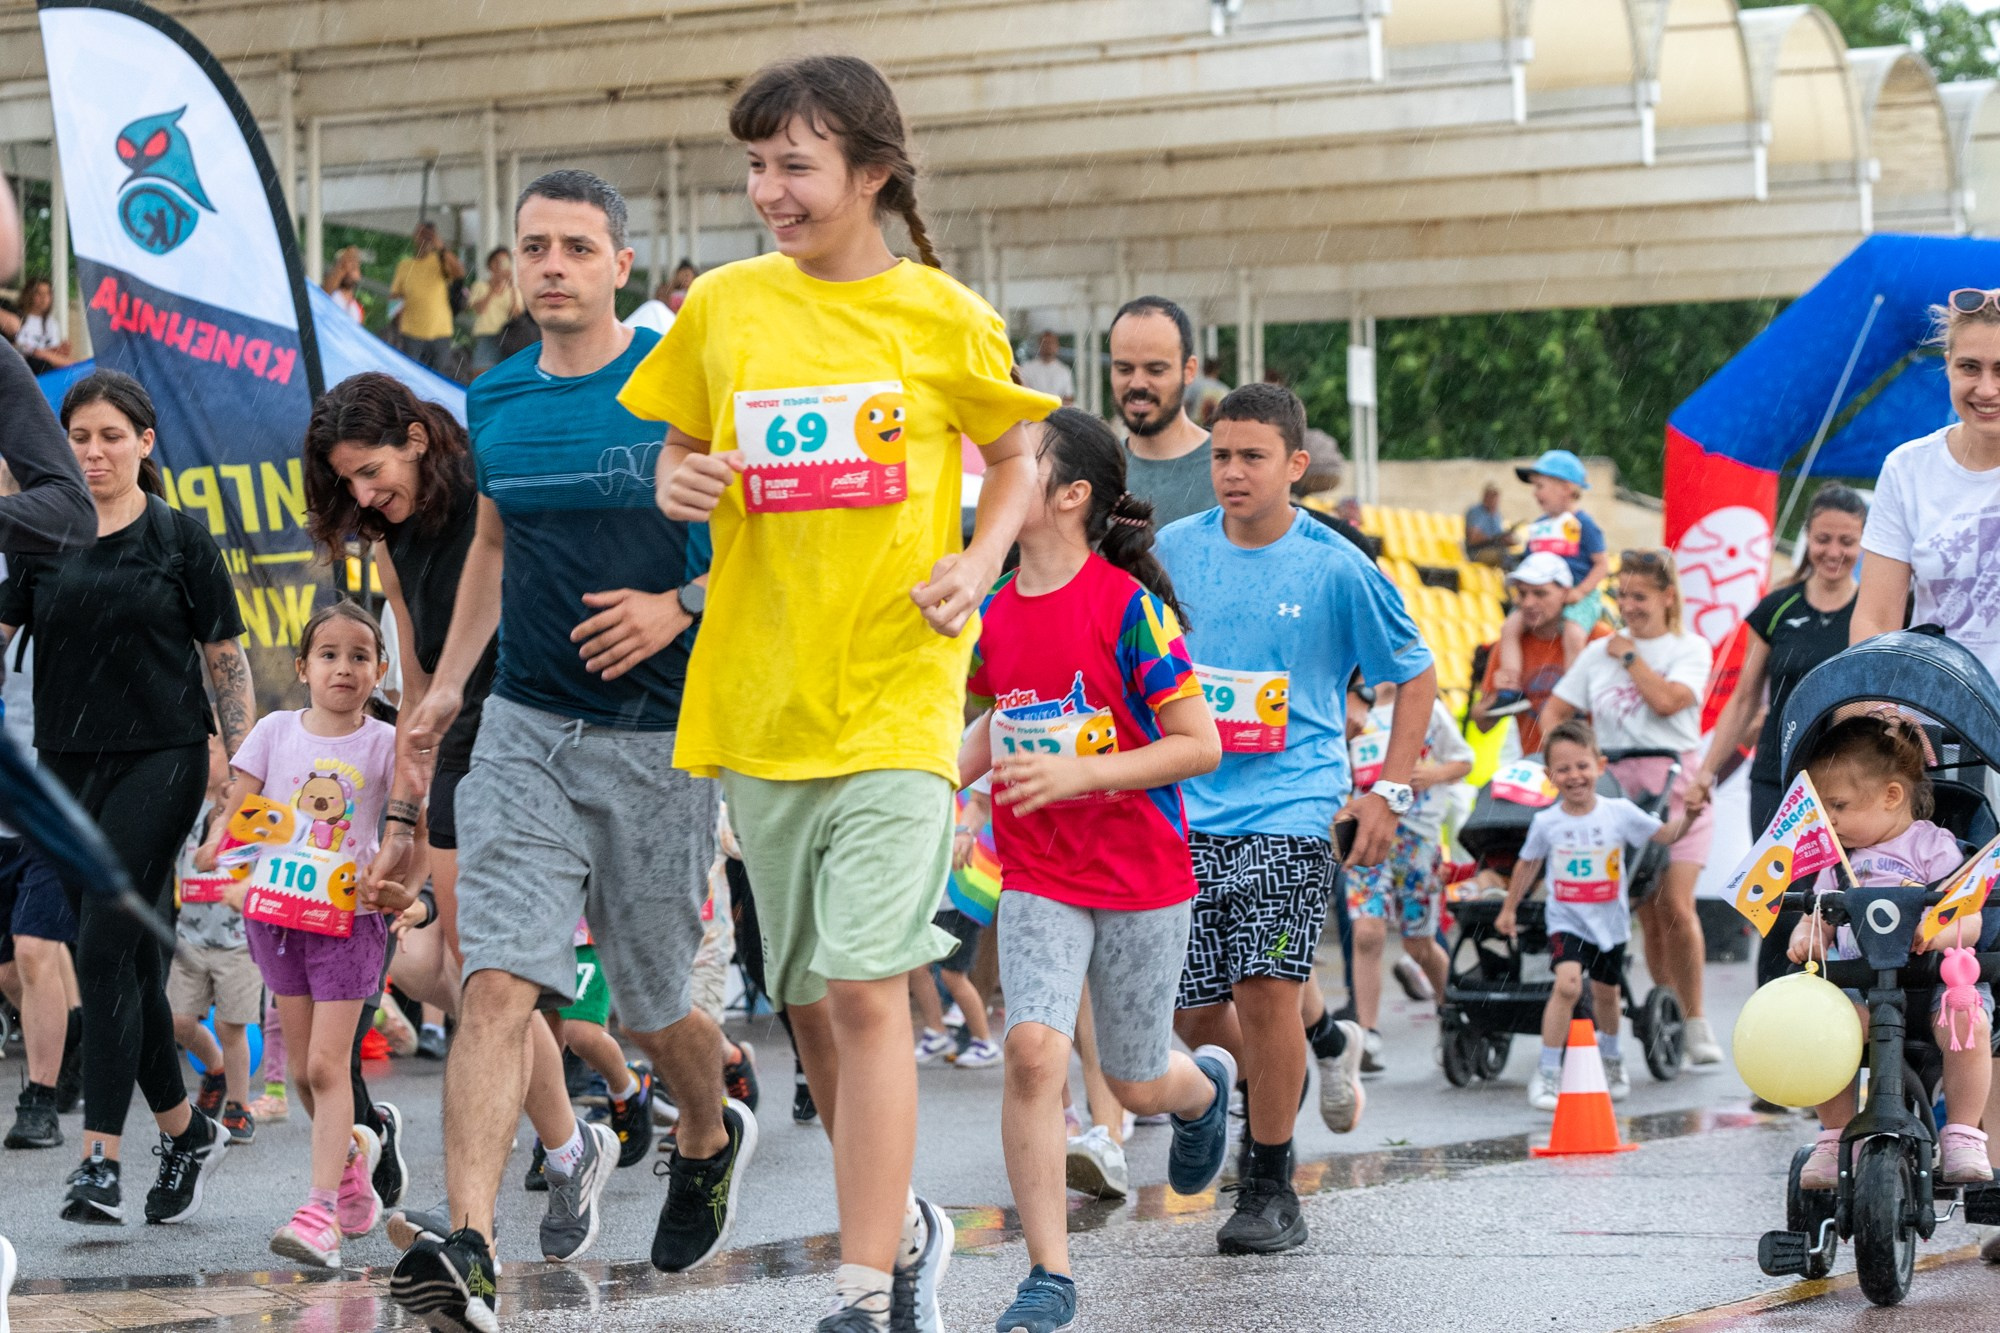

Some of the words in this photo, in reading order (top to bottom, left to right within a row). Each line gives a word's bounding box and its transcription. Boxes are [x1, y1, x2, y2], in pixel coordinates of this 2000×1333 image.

[765, 411, 828, 457] 69
[269, 857, 317, 893] 110
[1566, 858, 1592, 877] 45
[576, 962, 596, 1000] 7
